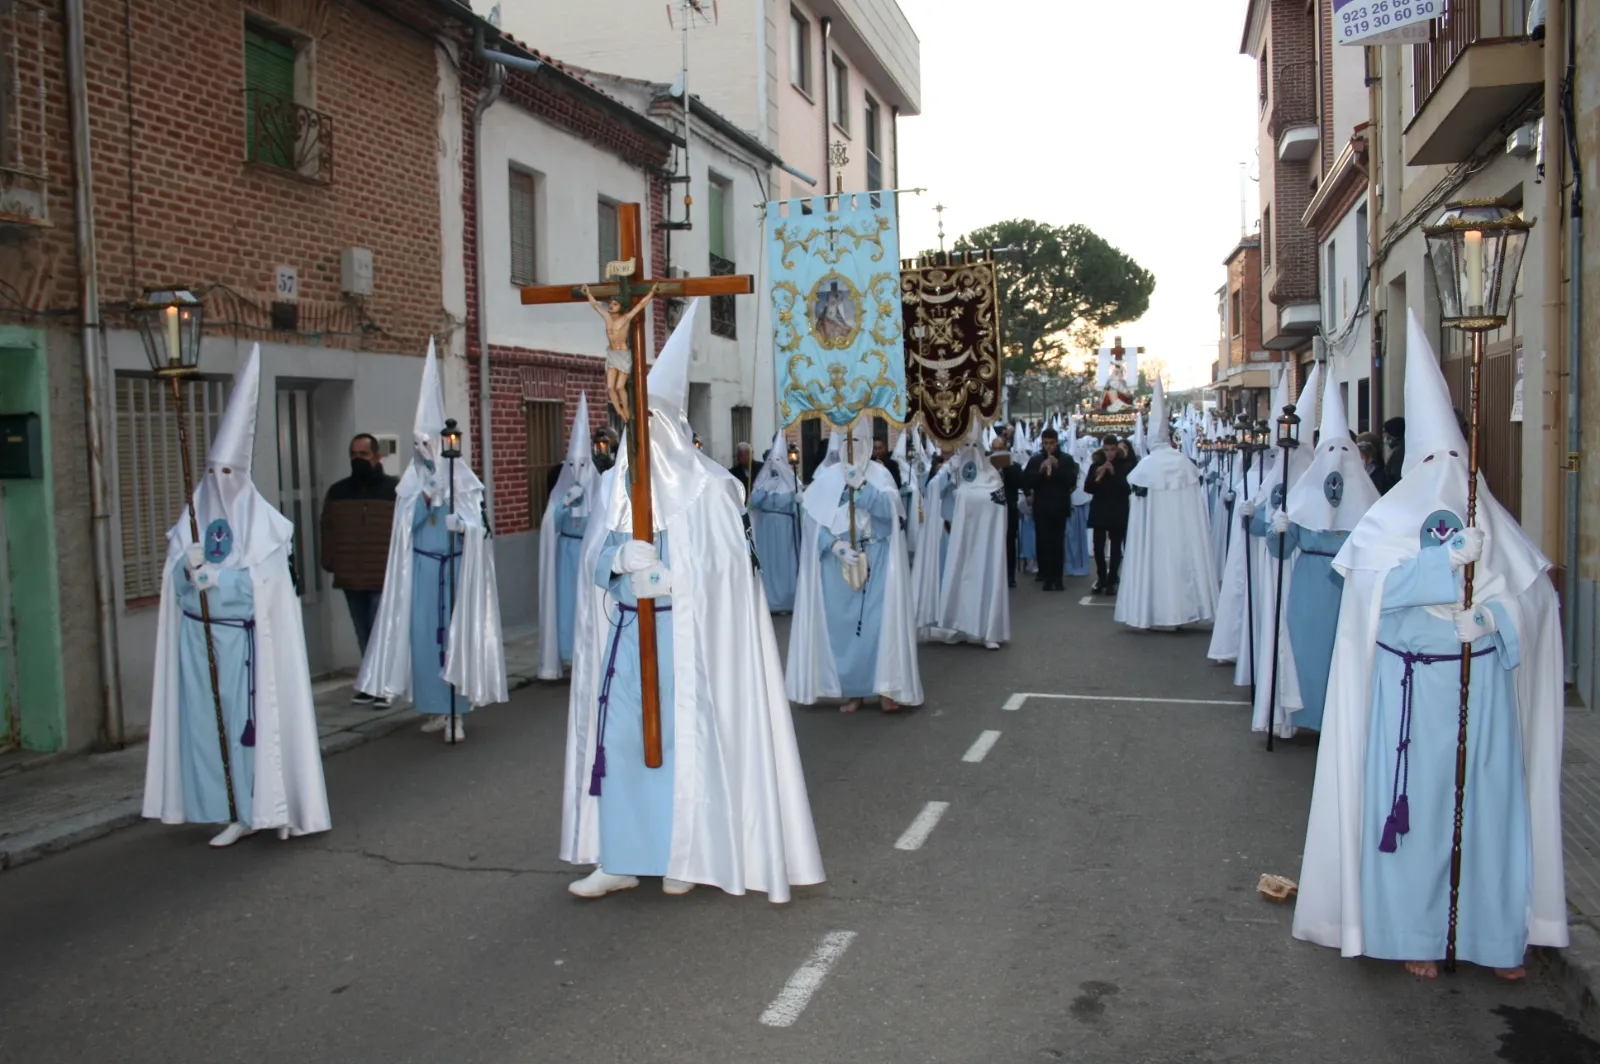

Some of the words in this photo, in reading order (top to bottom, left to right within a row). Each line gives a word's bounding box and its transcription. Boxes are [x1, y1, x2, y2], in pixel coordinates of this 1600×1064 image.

[1342, 7, 1368, 24] 923
[1371, 2, 1389, 15] 26
[1344, 20, 1370, 37] 619
[1373, 14, 1390, 28] 30
[1394, 7, 1412, 21] 60
[1416, 1, 1434, 16] 50
[279, 272, 295, 294] 57
